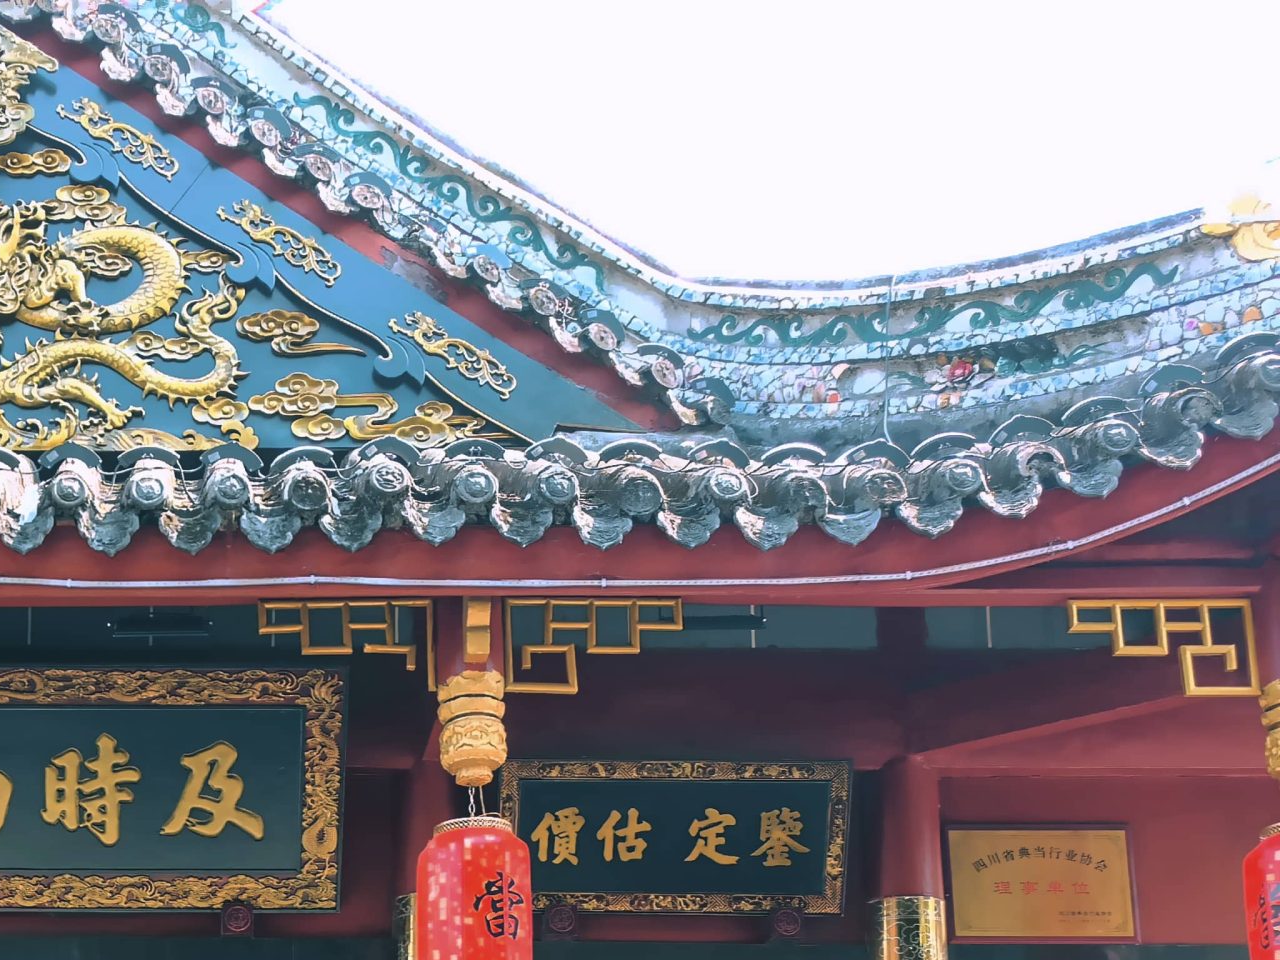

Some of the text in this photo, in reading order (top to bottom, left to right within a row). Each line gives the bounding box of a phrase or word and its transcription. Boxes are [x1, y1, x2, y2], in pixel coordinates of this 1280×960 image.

[972, 845, 1109, 874] 四川省典当行业协会
